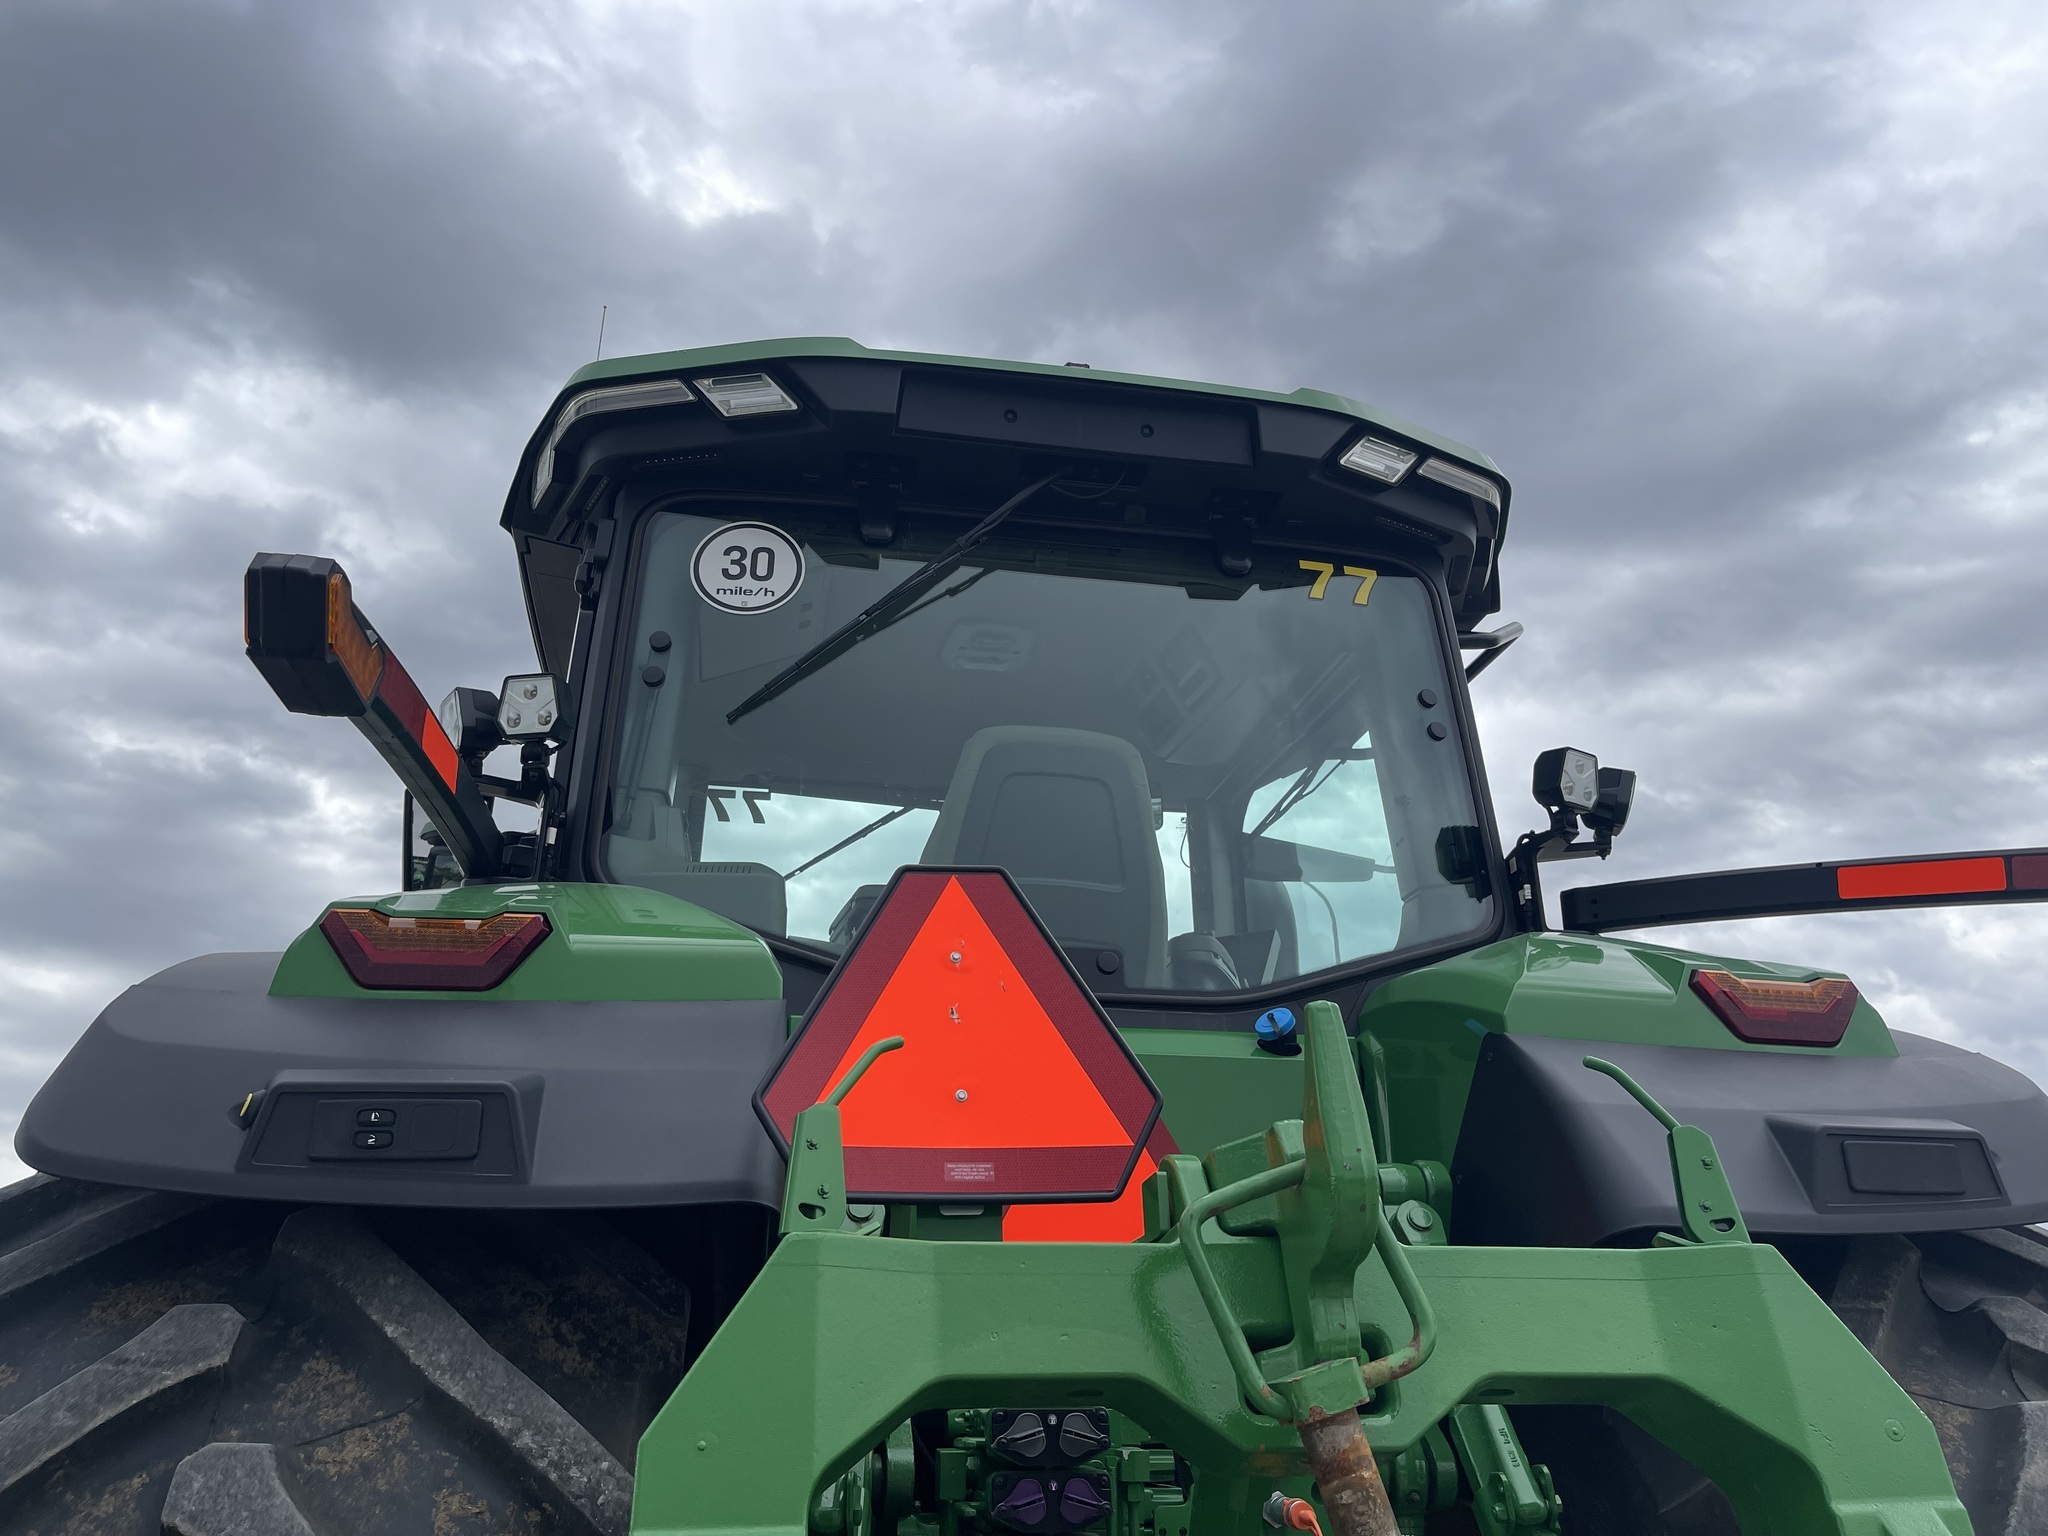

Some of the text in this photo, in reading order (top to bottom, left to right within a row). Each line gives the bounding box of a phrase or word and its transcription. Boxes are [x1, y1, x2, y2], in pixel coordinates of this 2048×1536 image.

[721, 545, 775, 582] 30
[716, 586, 775, 597] mile/h
[1298, 559, 1378, 606] 77
